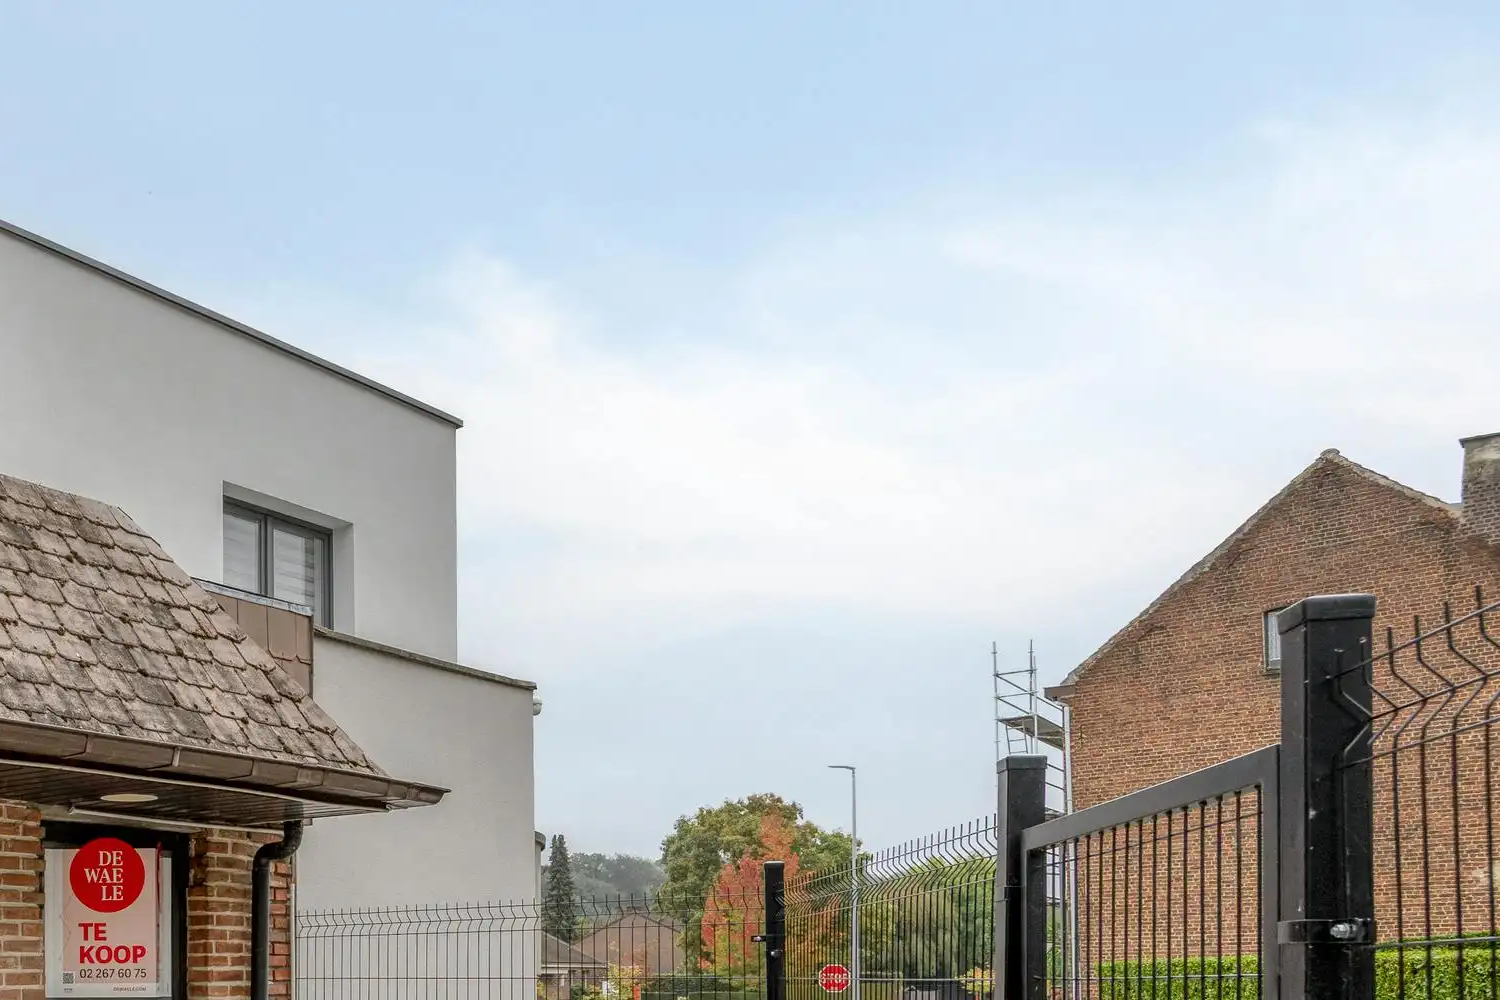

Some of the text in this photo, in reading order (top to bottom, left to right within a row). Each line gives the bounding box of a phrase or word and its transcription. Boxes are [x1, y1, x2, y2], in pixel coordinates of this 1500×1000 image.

[99, 850, 124, 866] DE
[84, 868, 124, 884] WAE
[101, 885, 124, 901] LE
[78, 922, 107, 941] TE
[79, 945, 147, 964] KOOP
[79, 968, 147, 979] 02 267 60 75
